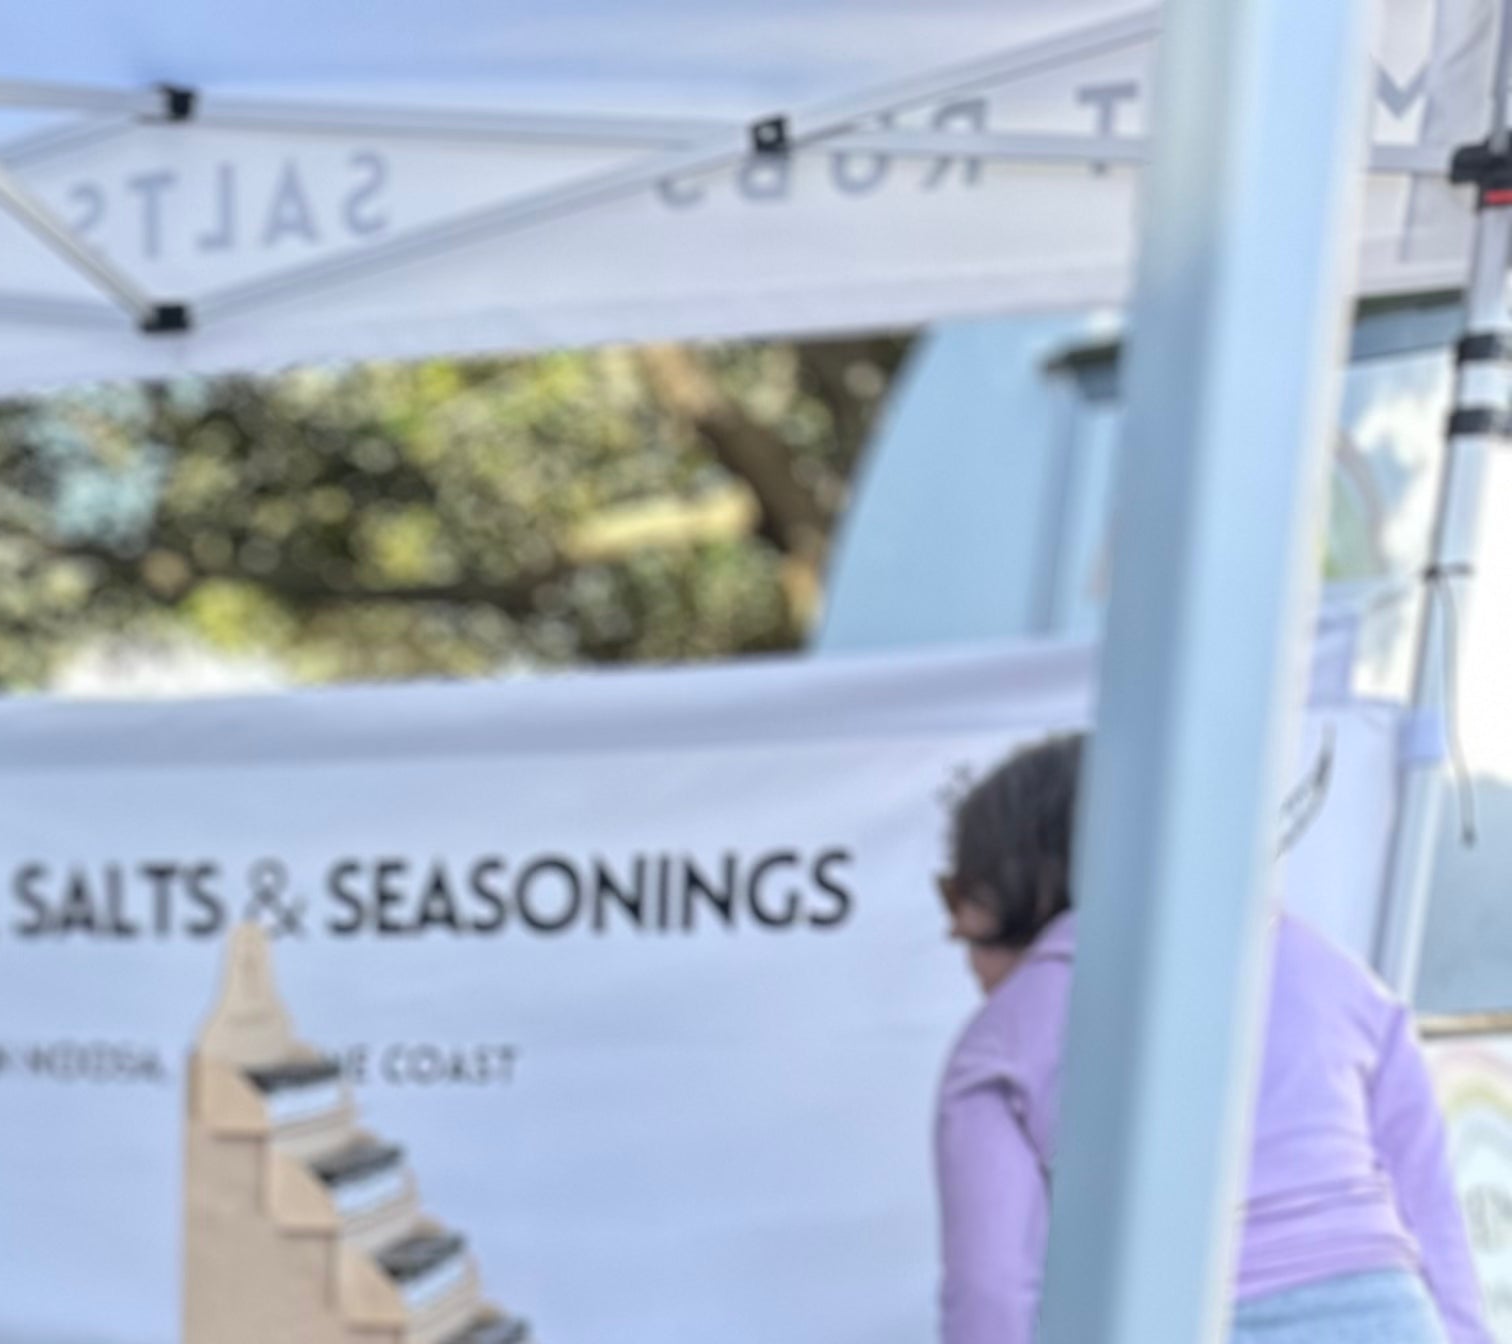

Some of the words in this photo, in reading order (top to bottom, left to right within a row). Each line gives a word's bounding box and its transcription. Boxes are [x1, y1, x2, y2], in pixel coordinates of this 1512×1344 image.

[12, 859, 227, 939] SALTS
[245, 856, 306, 938] &
[325, 848, 854, 938] SEASONINGS
[379, 1041, 521, 1086] COAST
